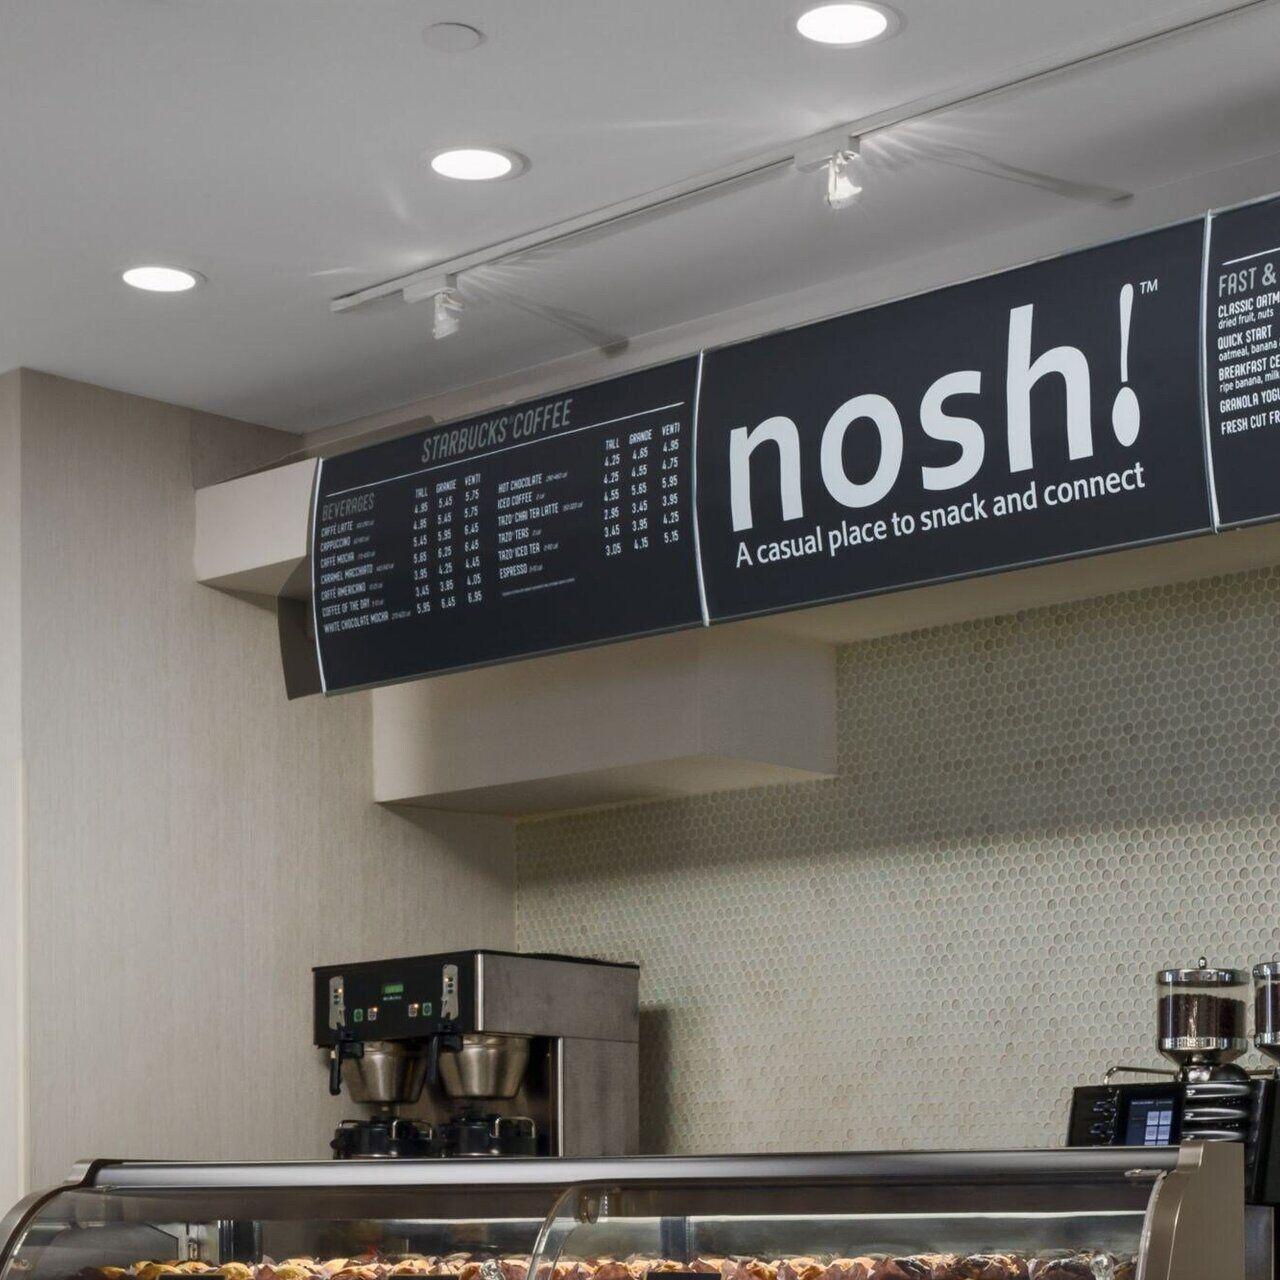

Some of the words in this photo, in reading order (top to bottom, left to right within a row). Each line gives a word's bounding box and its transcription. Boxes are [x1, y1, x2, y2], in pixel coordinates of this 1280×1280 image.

[1218, 266, 1257, 298] FAST
[1261, 262, 1277, 286] &
[1217, 315, 1237, 330] dried
[1238, 311, 1256, 325] fruit,
[1257, 307, 1274, 320] nuts
[1218, 297, 1254, 318] CLASSIC
[1217, 331, 1243, 350] QUICK
[1245, 324, 1272, 343] START
[1218, 345, 1250, 362] oatmeal,
[1250, 339, 1278, 354] banana
[1218, 357, 1267, 381] BREAKFAST
[730, 283, 1140, 532] nosh!
[1219, 392, 1259, 414] GRANOLA
[509, 398, 573, 439] COFFEE
[1220, 416, 1249, 435] FRESH
[1249, 412, 1267, 429] CUT
[498, 481, 509, 493] HOT
[510, 473, 542, 491] CHOCOLATE
[321, 492, 375, 522] BEVERAGES
[497, 497, 510, 509] ICED
[511, 491, 532, 506] COFFEE
[736, 541, 753, 568] A
[757, 526, 822, 564] casual
[830, 518, 886, 556] place
[891, 512, 915, 537] to
[920, 492, 986, 532] snack
[993, 482, 1038, 515] and
[1043, 462, 1145, 504] connect
[499, 563, 527, 579] ESPRESSO
